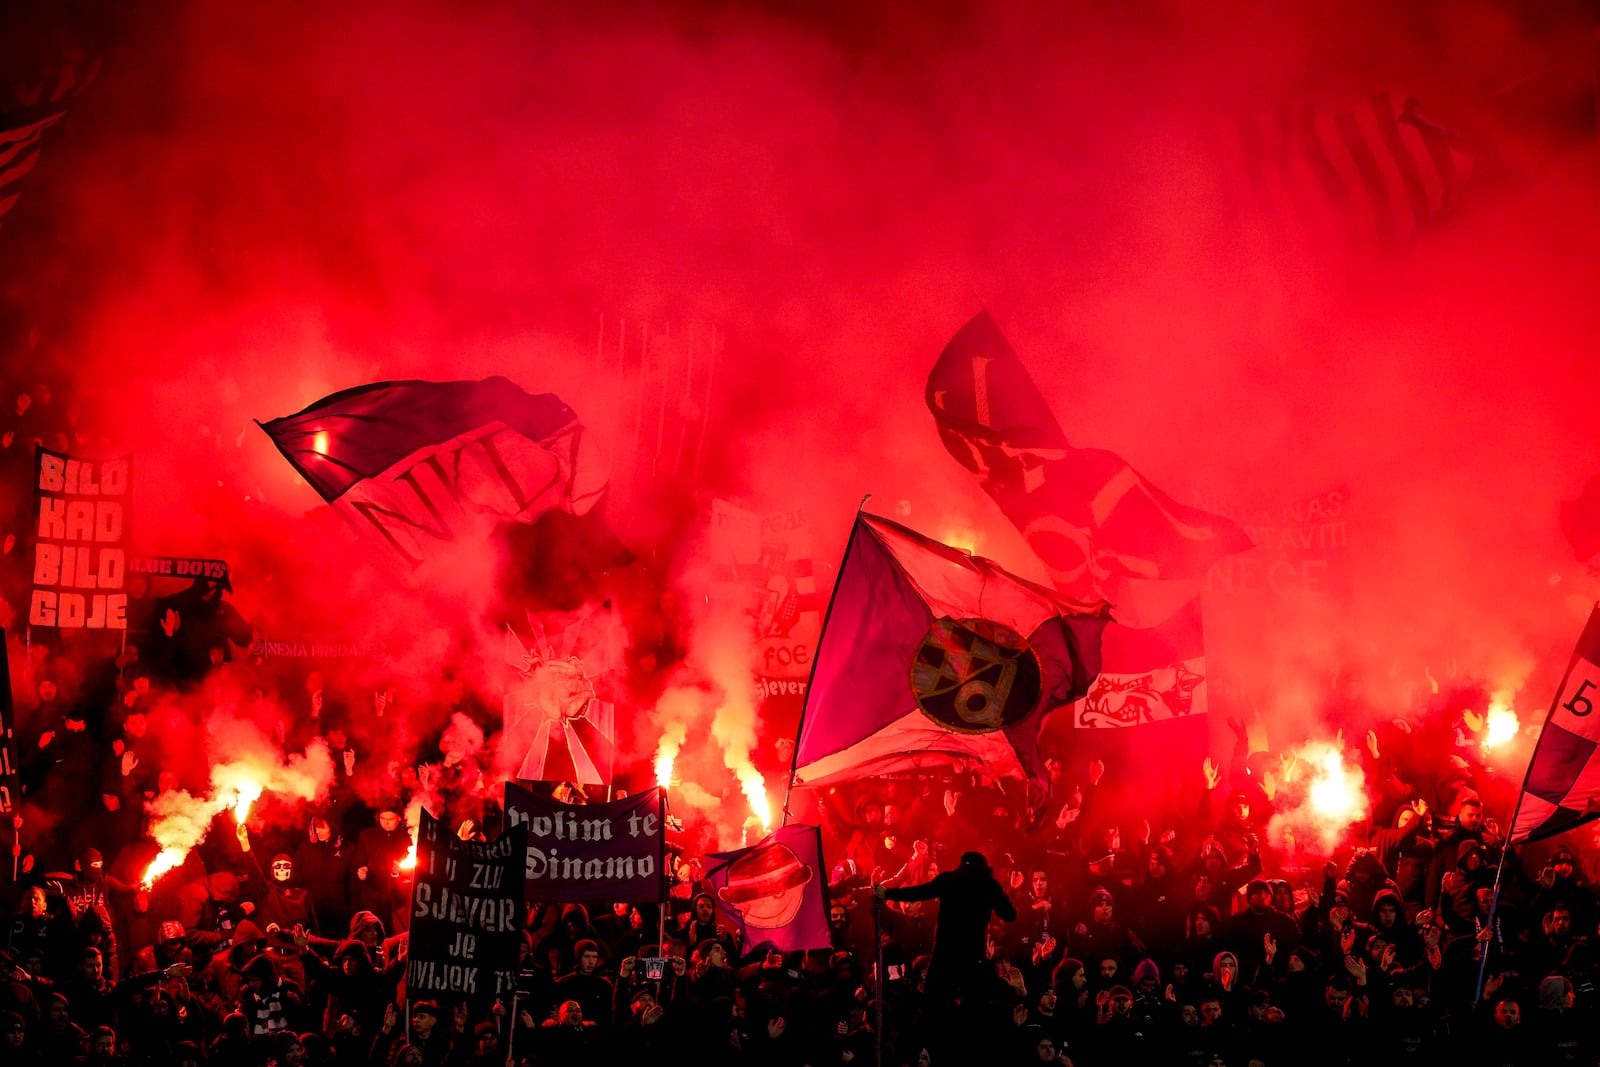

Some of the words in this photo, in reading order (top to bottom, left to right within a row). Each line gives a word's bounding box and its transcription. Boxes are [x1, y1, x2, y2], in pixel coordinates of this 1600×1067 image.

[39, 453, 128, 495] BILO
[38, 496, 124, 542] KAD
[1283, 491, 1343, 522] NAS
[33, 543, 125, 589] BILO
[177, 560, 226, 578] BOYS
[29, 589, 127, 629] GDJE
[267, 642, 307, 657] NEMA
[626, 809, 659, 838] te
[525, 848, 655, 880] Dinamo
